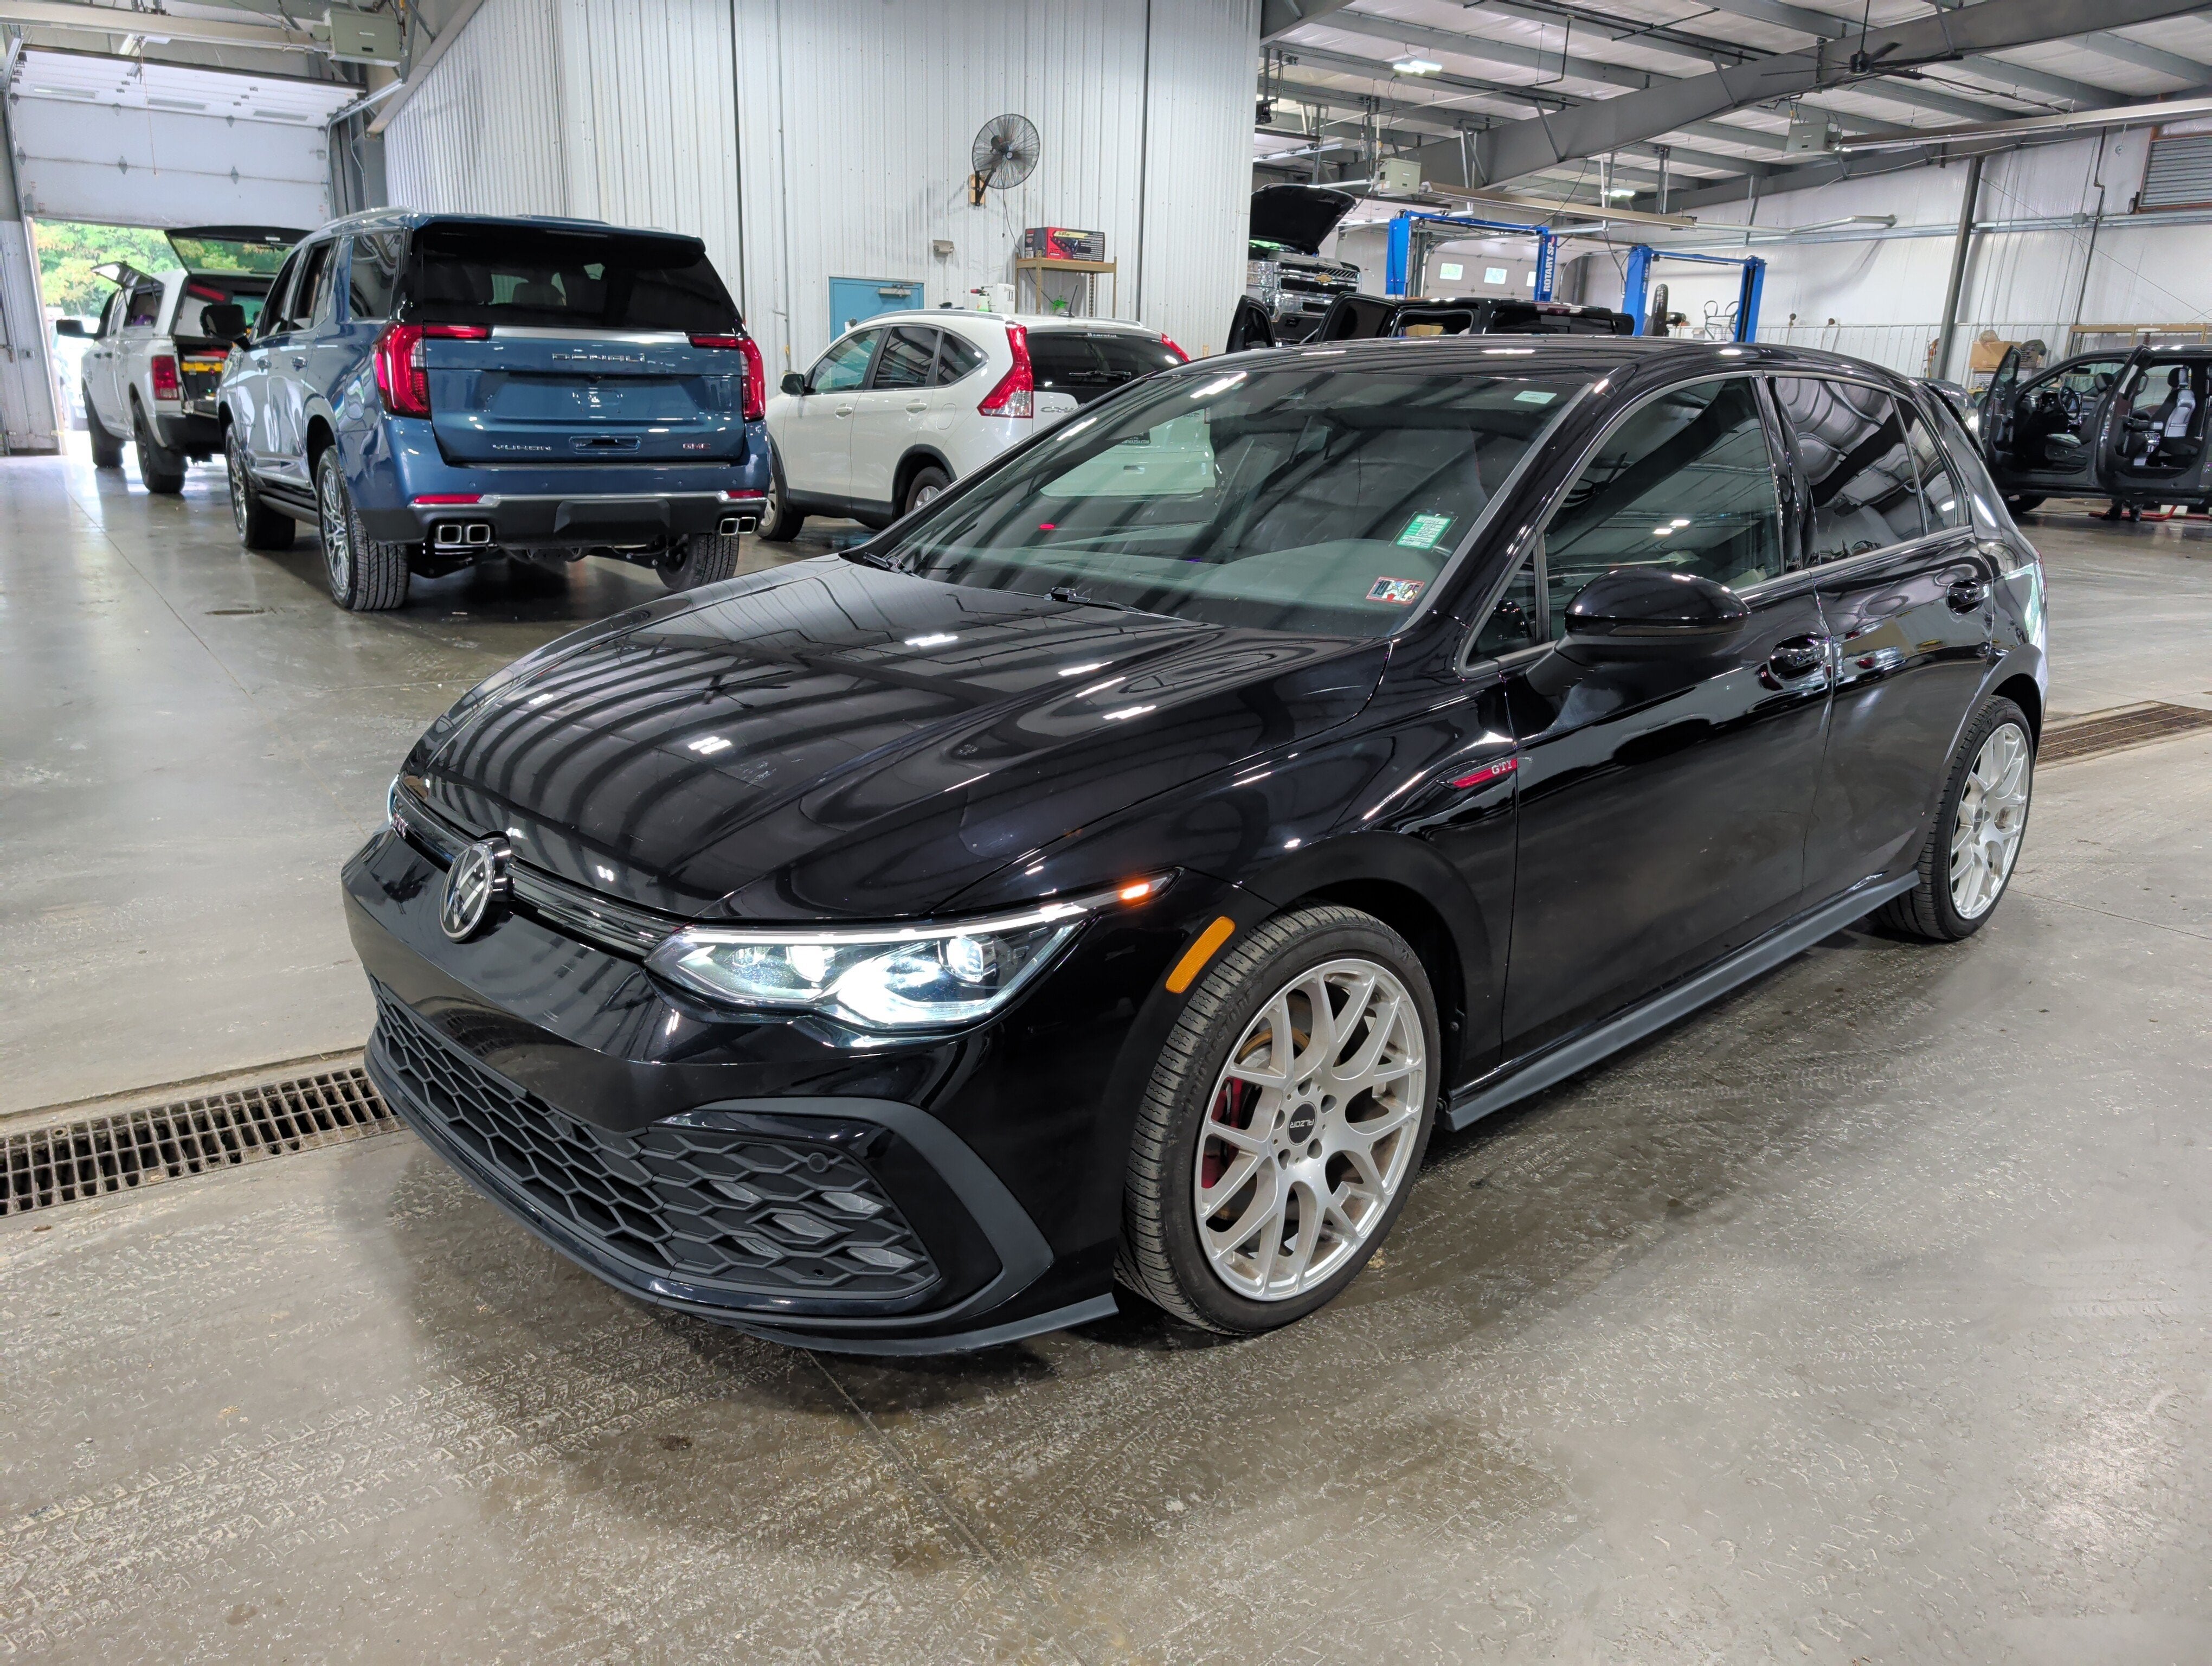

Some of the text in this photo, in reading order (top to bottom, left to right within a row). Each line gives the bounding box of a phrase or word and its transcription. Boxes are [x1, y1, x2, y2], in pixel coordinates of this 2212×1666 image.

[1543, 255, 1554, 292] ROTARY
[552, 353, 646, 362] DENALI
[1491, 760, 1513, 775] GTI
[1290, 1119, 1314, 1129] ALZOR
